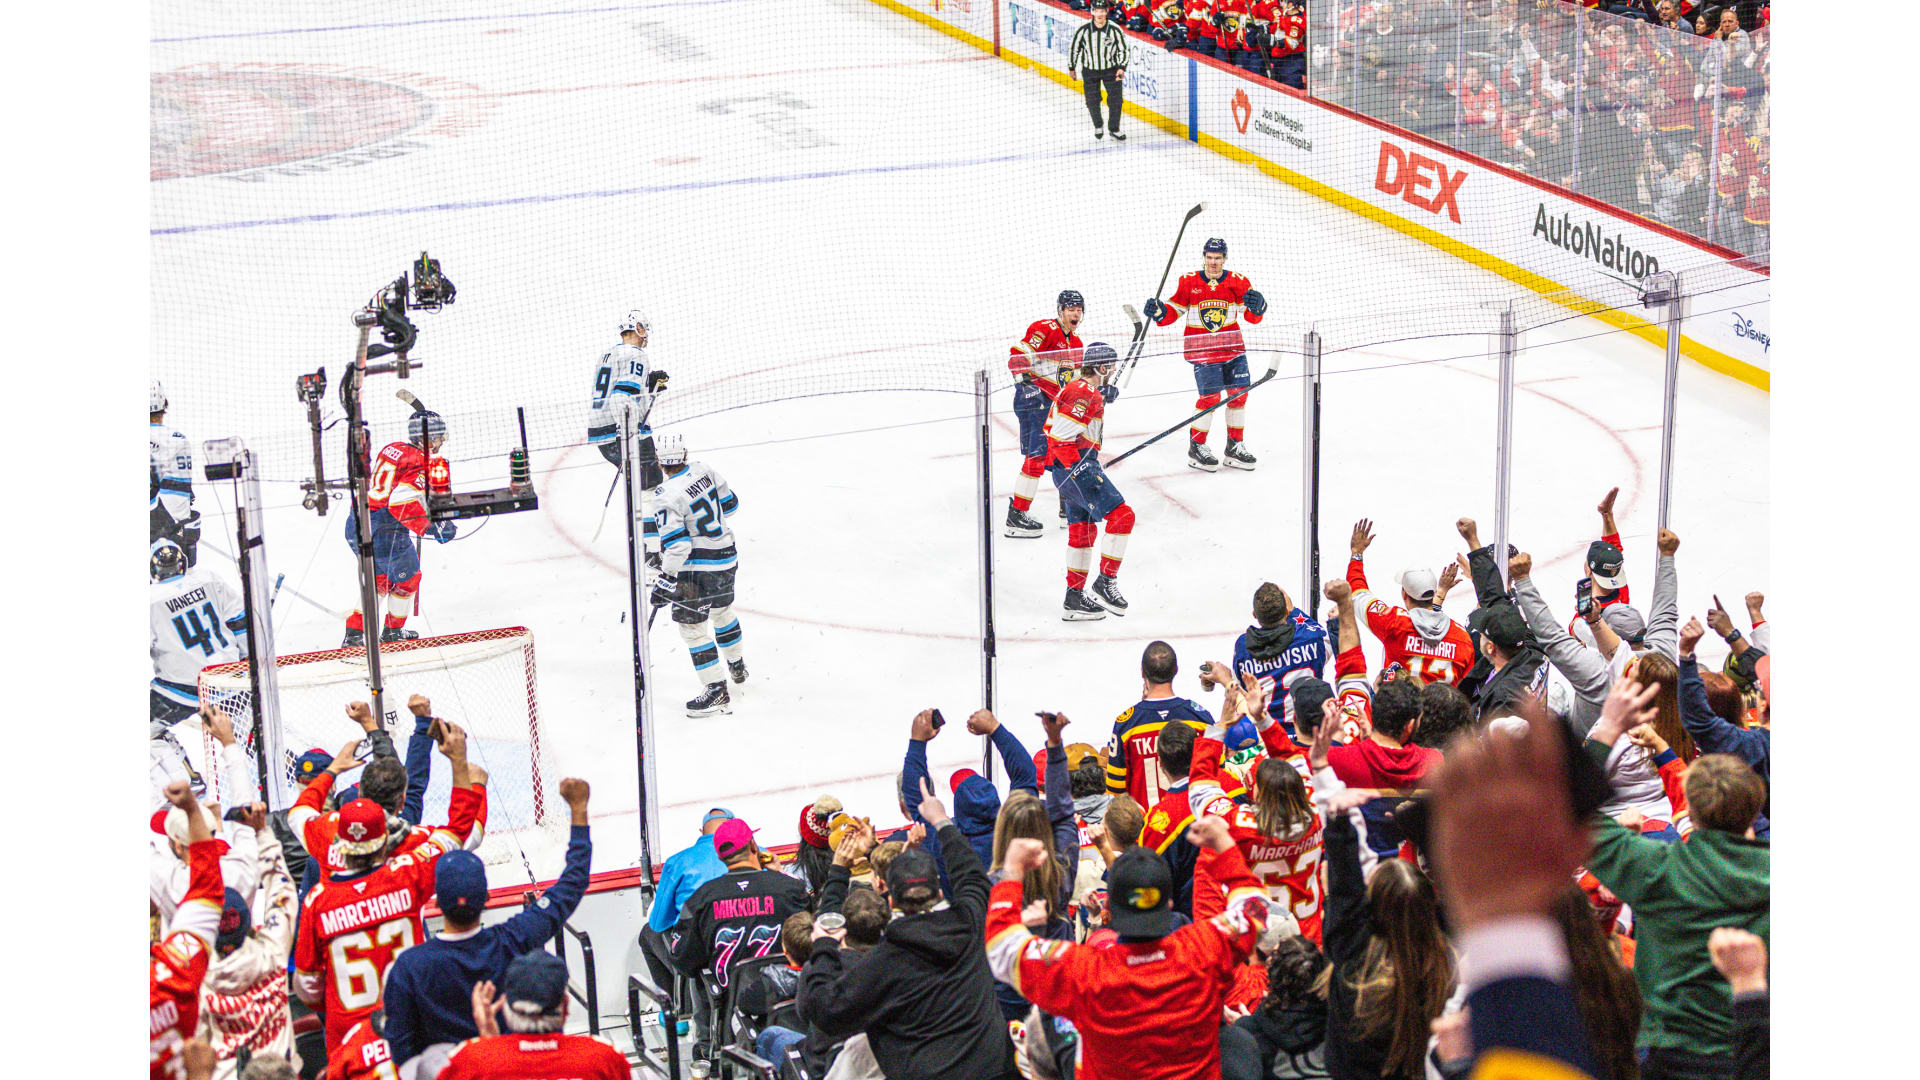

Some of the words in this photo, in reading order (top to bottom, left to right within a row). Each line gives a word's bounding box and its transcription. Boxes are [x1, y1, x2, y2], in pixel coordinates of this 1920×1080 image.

[1123, 72, 1158, 100] SINESS
[1254, 119, 1285, 142] Children's
[1286, 133, 1313, 152] Hospital
[1262, 108, 1273, 120] Joe
[1274, 111, 1304, 133] DiMaggio
[1374, 140, 1469, 224] DEX
[1533, 202, 1659, 279] AutoNation
[629, 360, 645, 377] 19
[685, 474, 713, 499] HAYTON
[689, 487, 723, 538] 27
[171, 601, 229, 657] 41
[1249, 830, 1324, 861] MARCHAN
[320, 888, 413, 936] MARCHAND
[713, 895, 775, 920] MIKKOLA
[715, 923, 782, 988] 77
